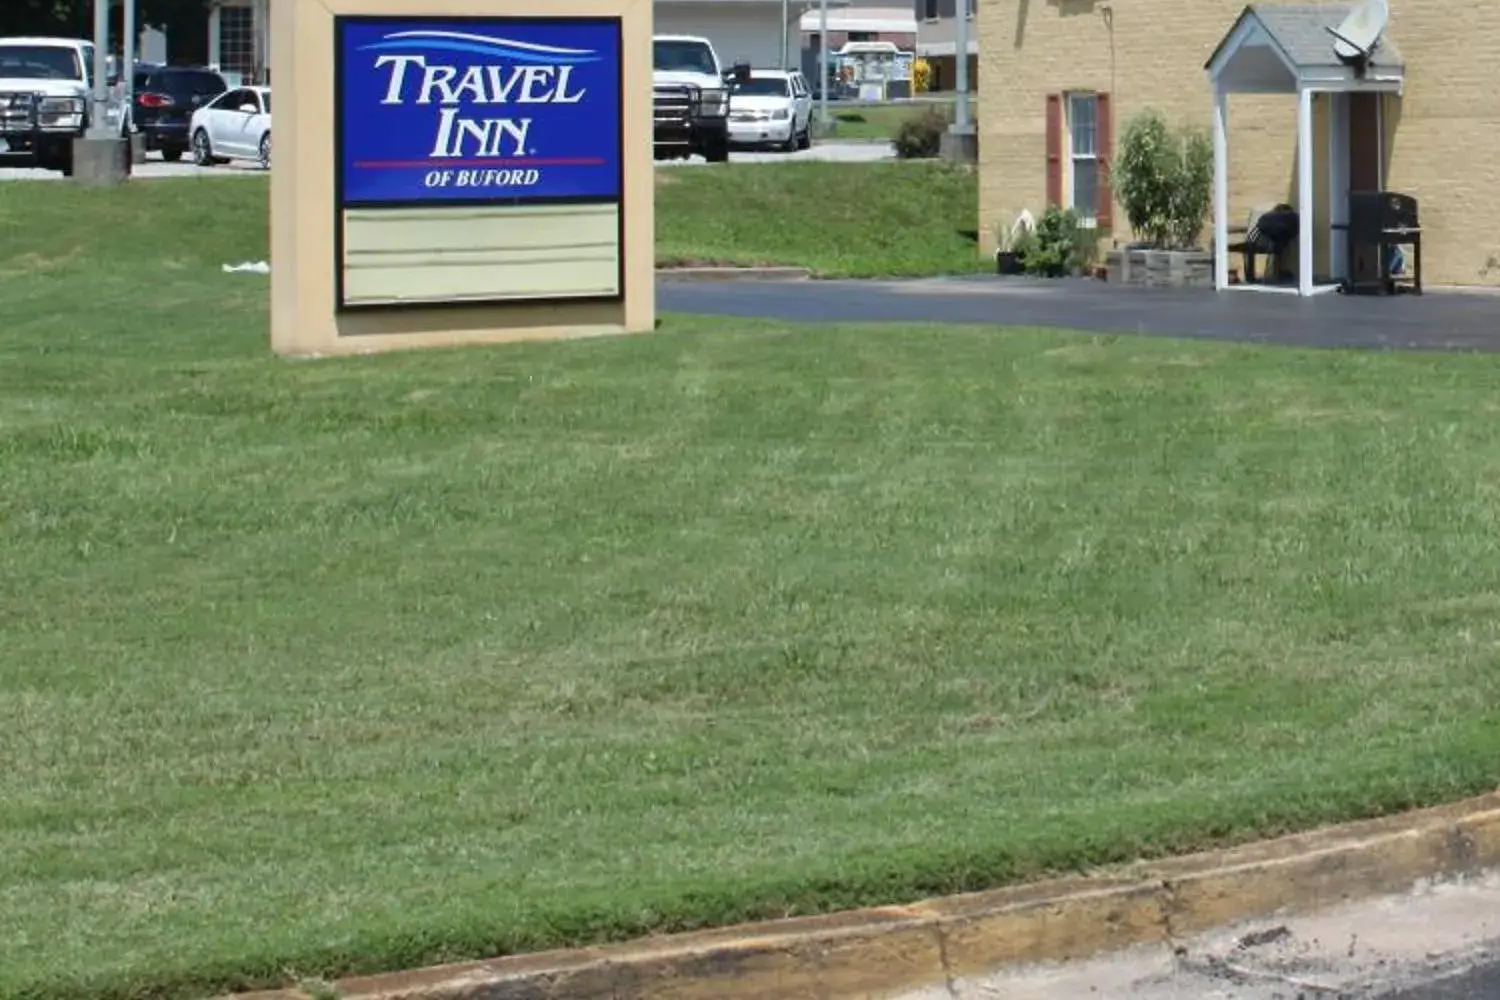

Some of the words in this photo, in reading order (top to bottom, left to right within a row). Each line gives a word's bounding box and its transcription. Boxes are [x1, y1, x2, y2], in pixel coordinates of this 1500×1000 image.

[373, 55, 586, 104] TRAVEL
[428, 107, 533, 157] INN
[424, 171, 453, 188] OF
[455, 169, 539, 187] BUFORD
